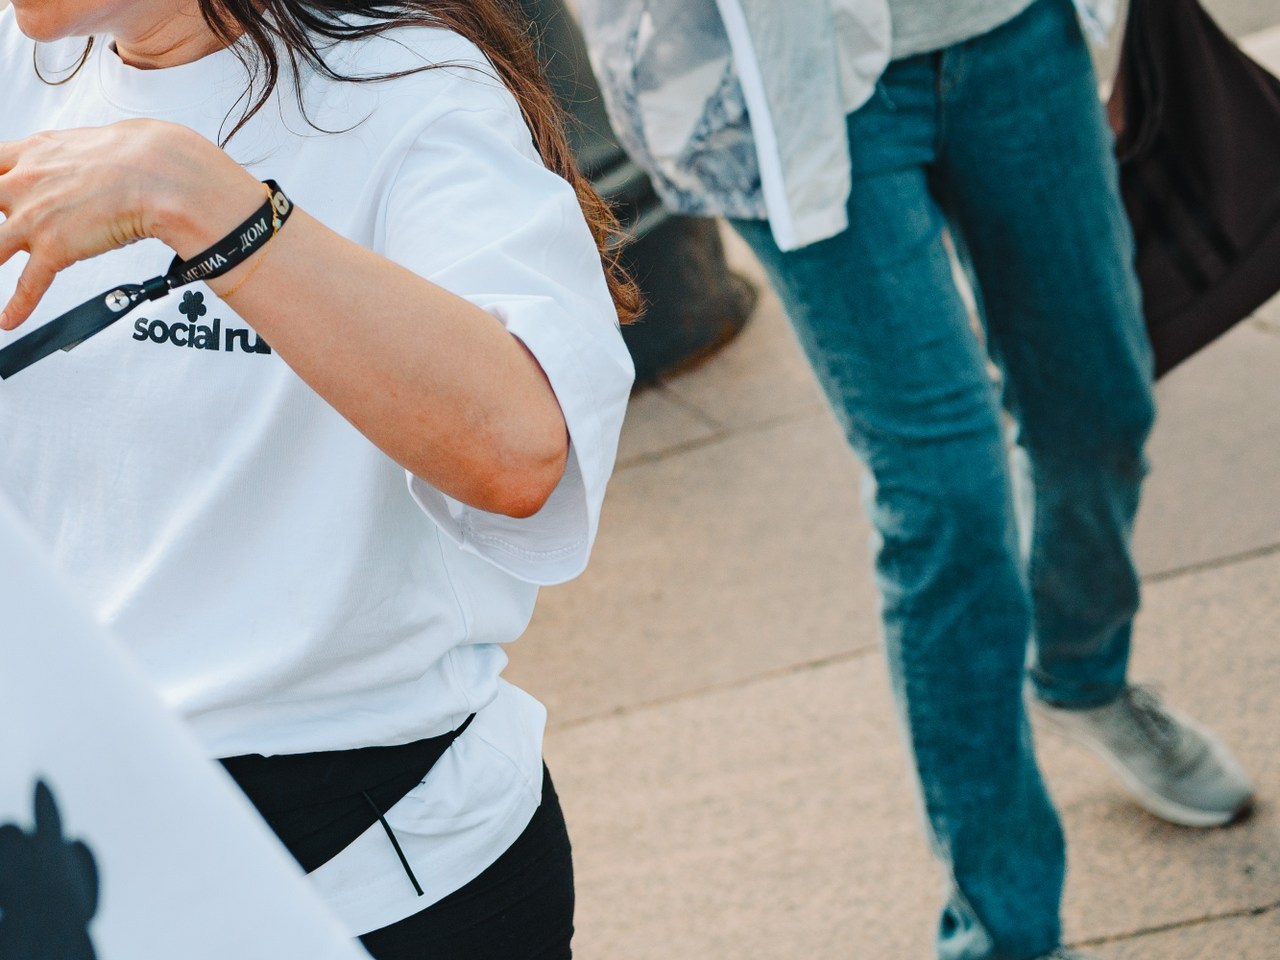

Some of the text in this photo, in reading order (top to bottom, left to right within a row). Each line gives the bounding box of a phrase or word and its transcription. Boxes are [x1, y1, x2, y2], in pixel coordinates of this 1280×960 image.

[181, 253, 228, 283] МЕДИА
[239, 217, 269, 252] ДОМ
[132, 314, 221, 351] social
